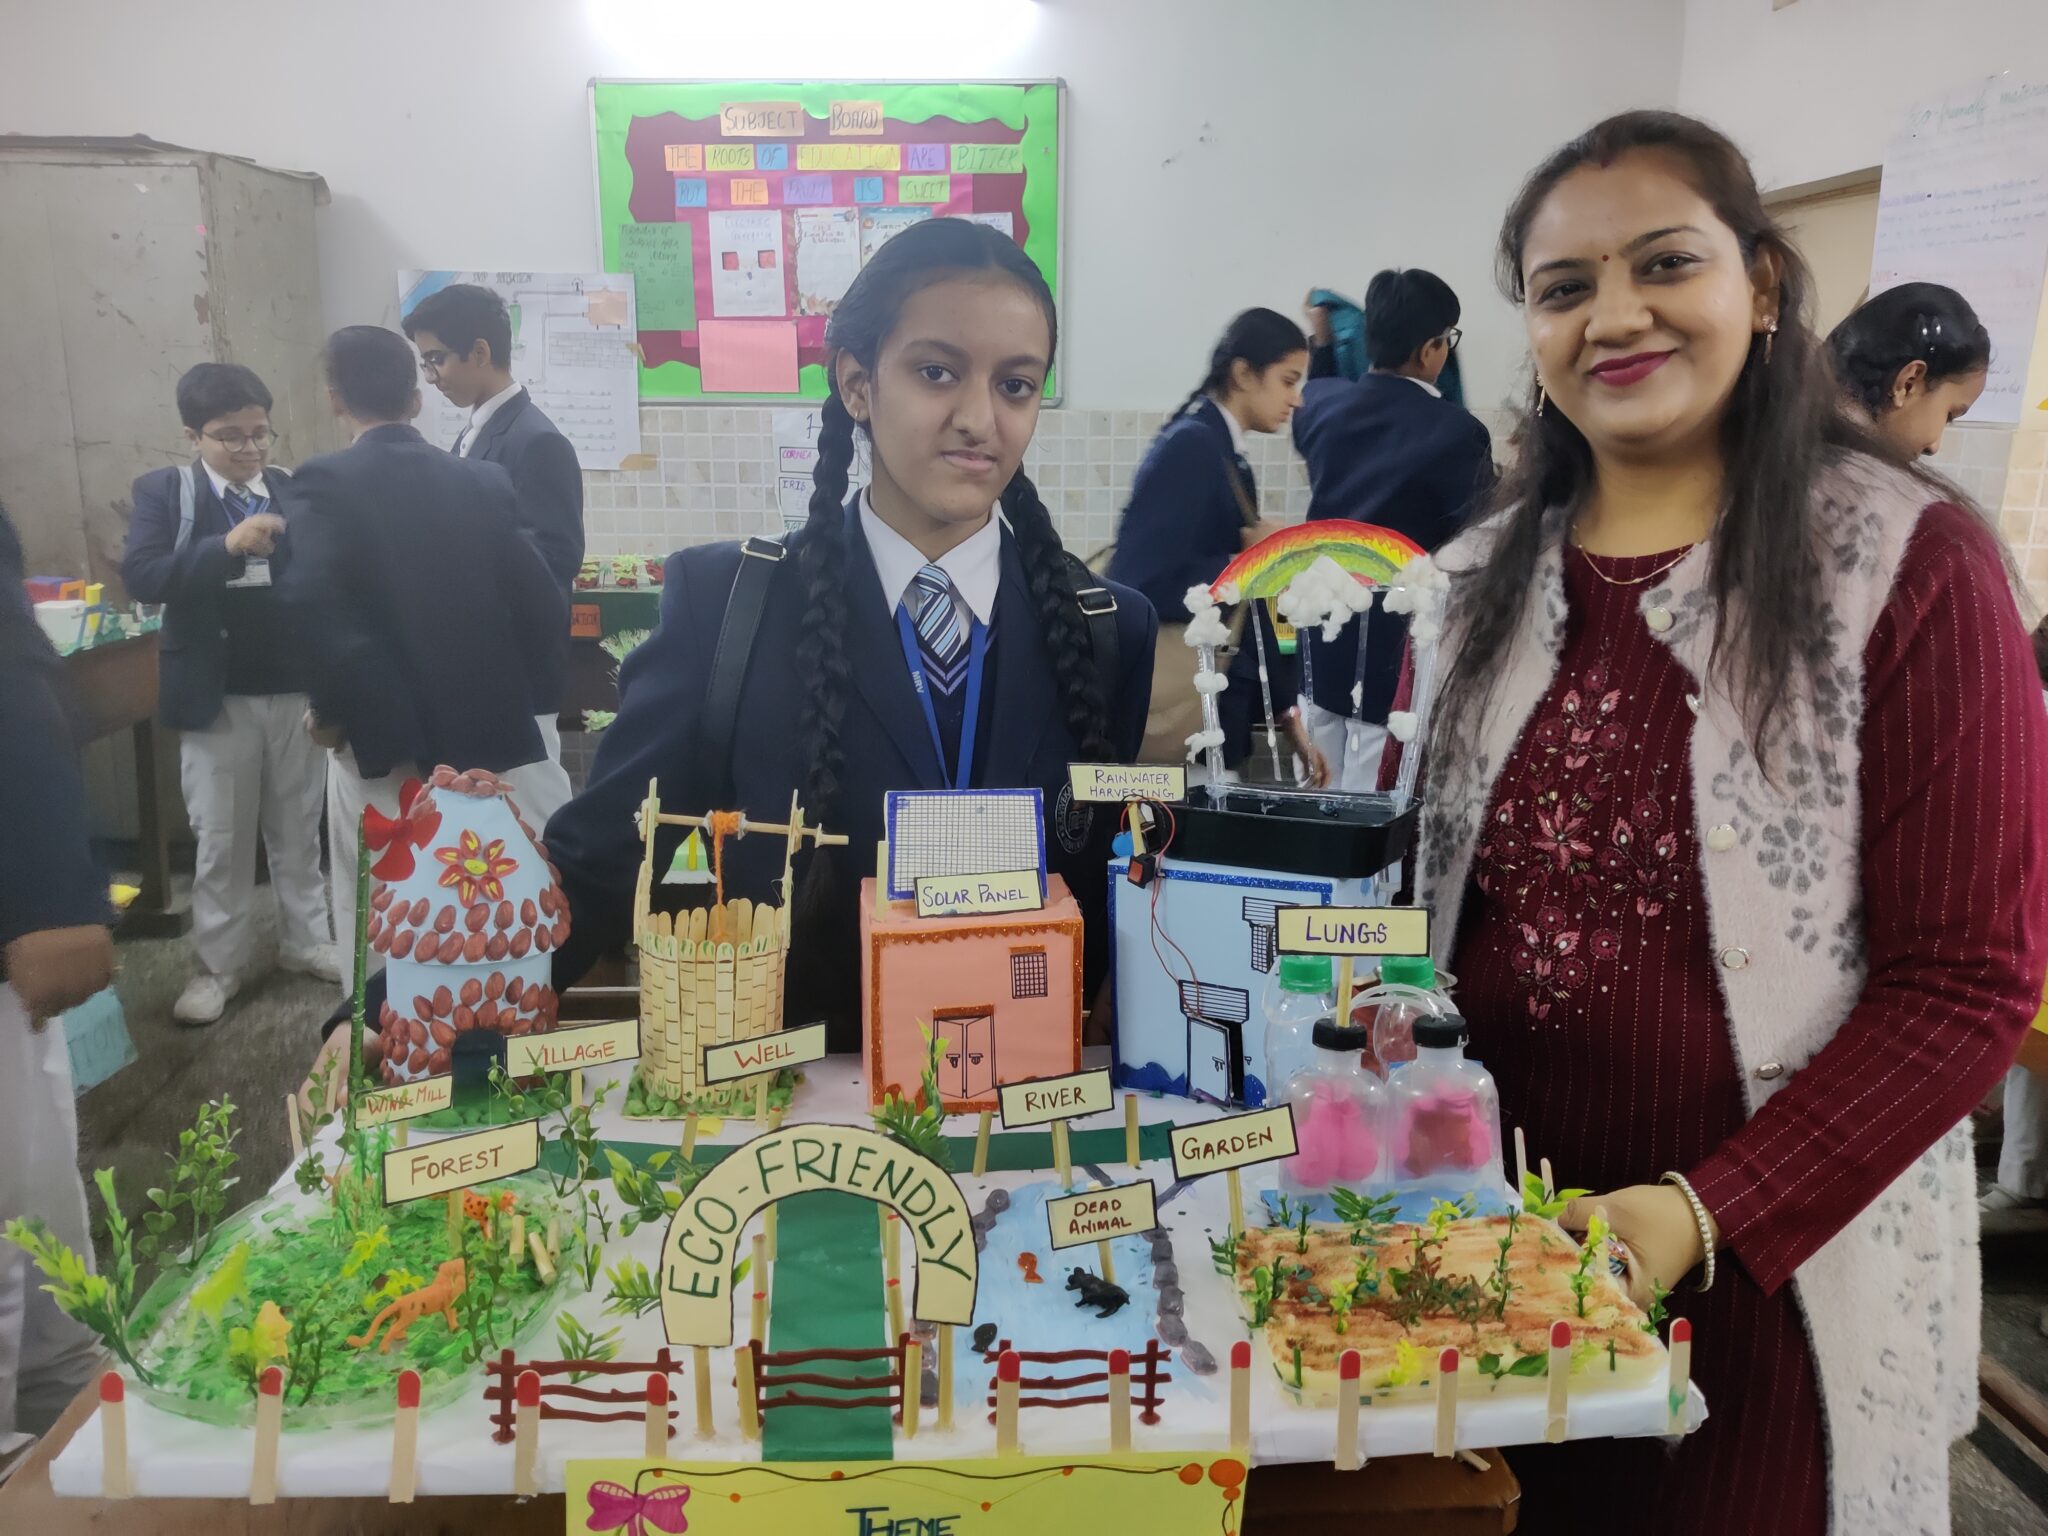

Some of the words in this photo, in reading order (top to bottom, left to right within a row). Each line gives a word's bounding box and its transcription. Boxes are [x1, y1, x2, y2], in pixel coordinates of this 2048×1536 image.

[724, 107, 799, 131] SUBJECT
[830, 106, 879, 130] BOARD
[668, 146, 697, 168] THE
[711, 147, 750, 167] ROOTS
[761, 147, 778, 167] OF
[800, 146, 899, 168] EDUCATION
[910, 147, 936, 167] ARE
[957, 146, 1016, 168] BITTER
[735, 180, 763, 202] THE
[857, 179, 879, 200] IS
[905, 180, 946, 200] SWEET
[783, 480, 806, 491] IRIS
[911, 670, 924, 694] MRV
[1089, 785, 1175, 799] HARVESTING
[922, 886, 974, 908] SOLAR
[978, 884, 1029, 904] PANEL
[1306, 915, 1388, 944] LUNGS
[524, 1040, 617, 1067] VILLAGE
[734, 1041, 796, 1069] WELL
[1025, 1086, 1086, 1112] RIVER
[1181, 1126, 1273, 1161] GARDEN
[410, 1144, 504, 1185] FOREST
[1074, 1198, 1122, 1217] DEAD
[1069, 1214, 1132, 1236] ANIMAL
[845, 1506, 961, 1536] THEME
